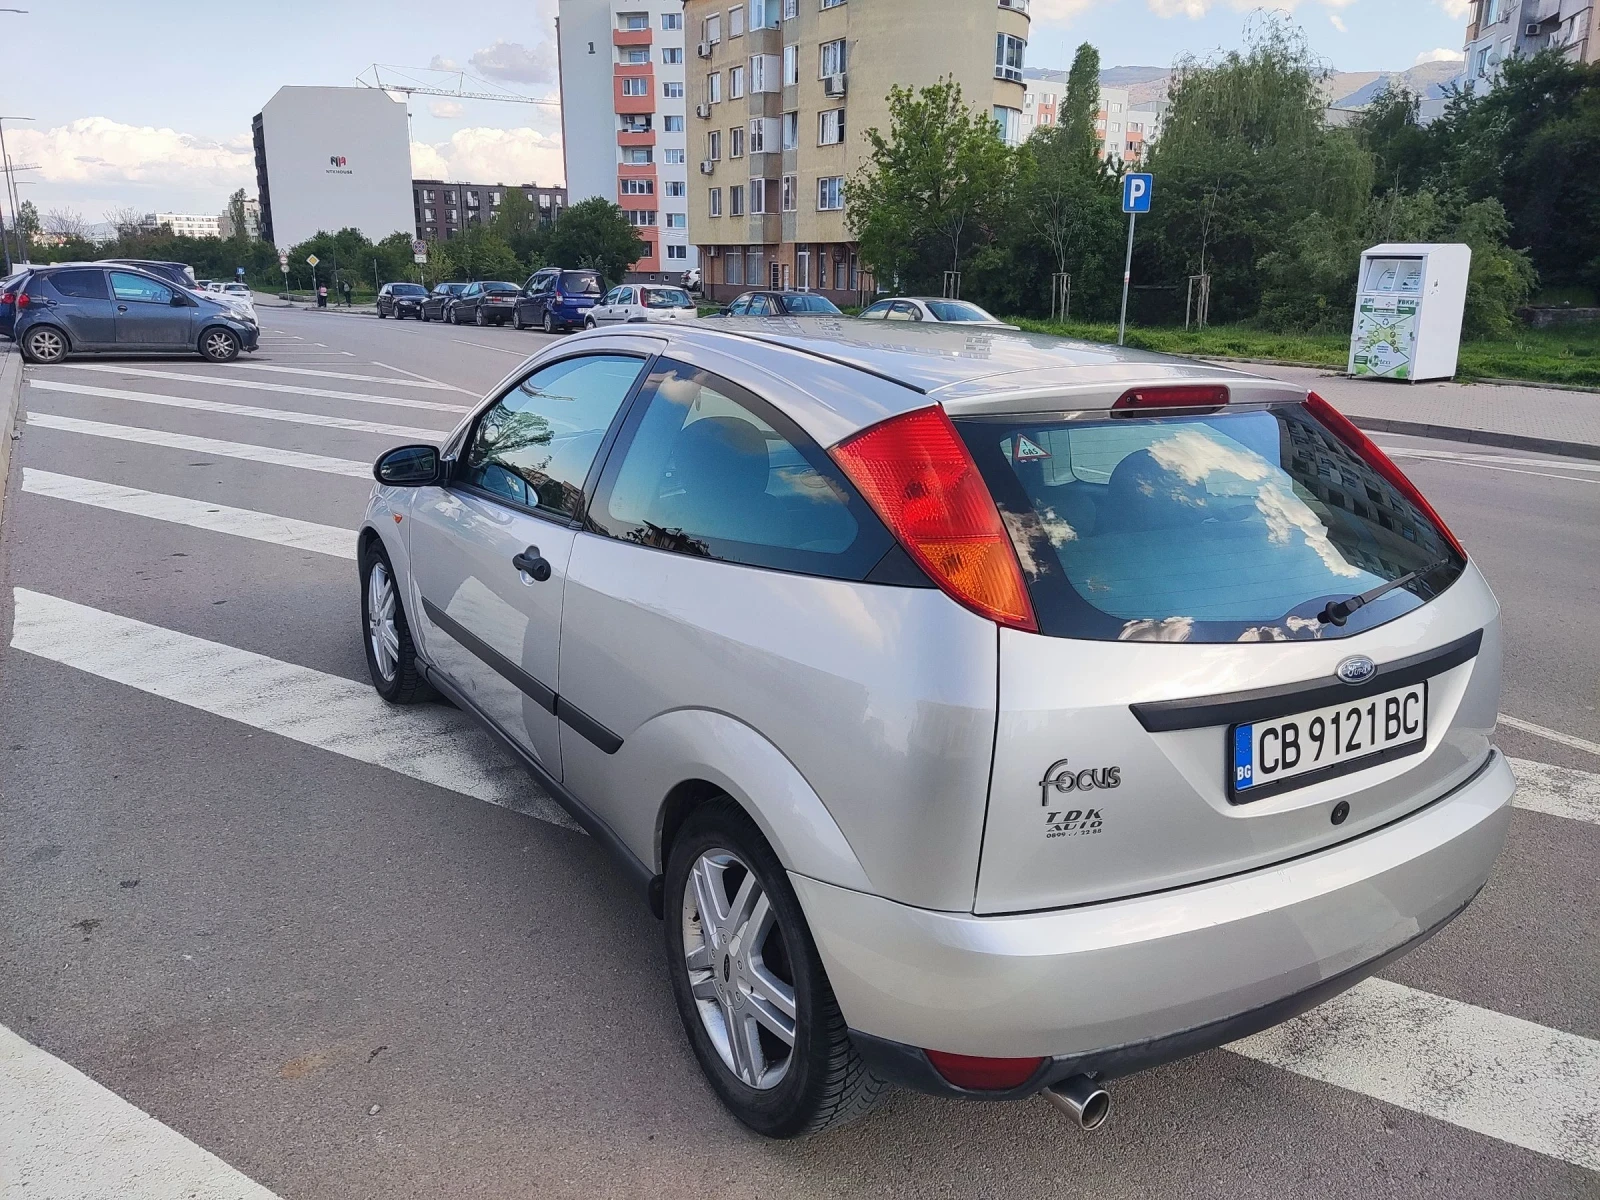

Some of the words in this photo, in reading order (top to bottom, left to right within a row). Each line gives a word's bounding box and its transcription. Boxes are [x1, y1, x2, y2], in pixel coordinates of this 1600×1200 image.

[588, 42, 596, 54] 1
[1129, 178, 1146, 208] P
[1259, 722, 1301, 775] CB
[1308, 702, 1376, 763] 9121
[1385, 691, 1420, 742] BC
[1237, 765, 1251, 781] BG
[1046, 808, 1104, 824] TDK
